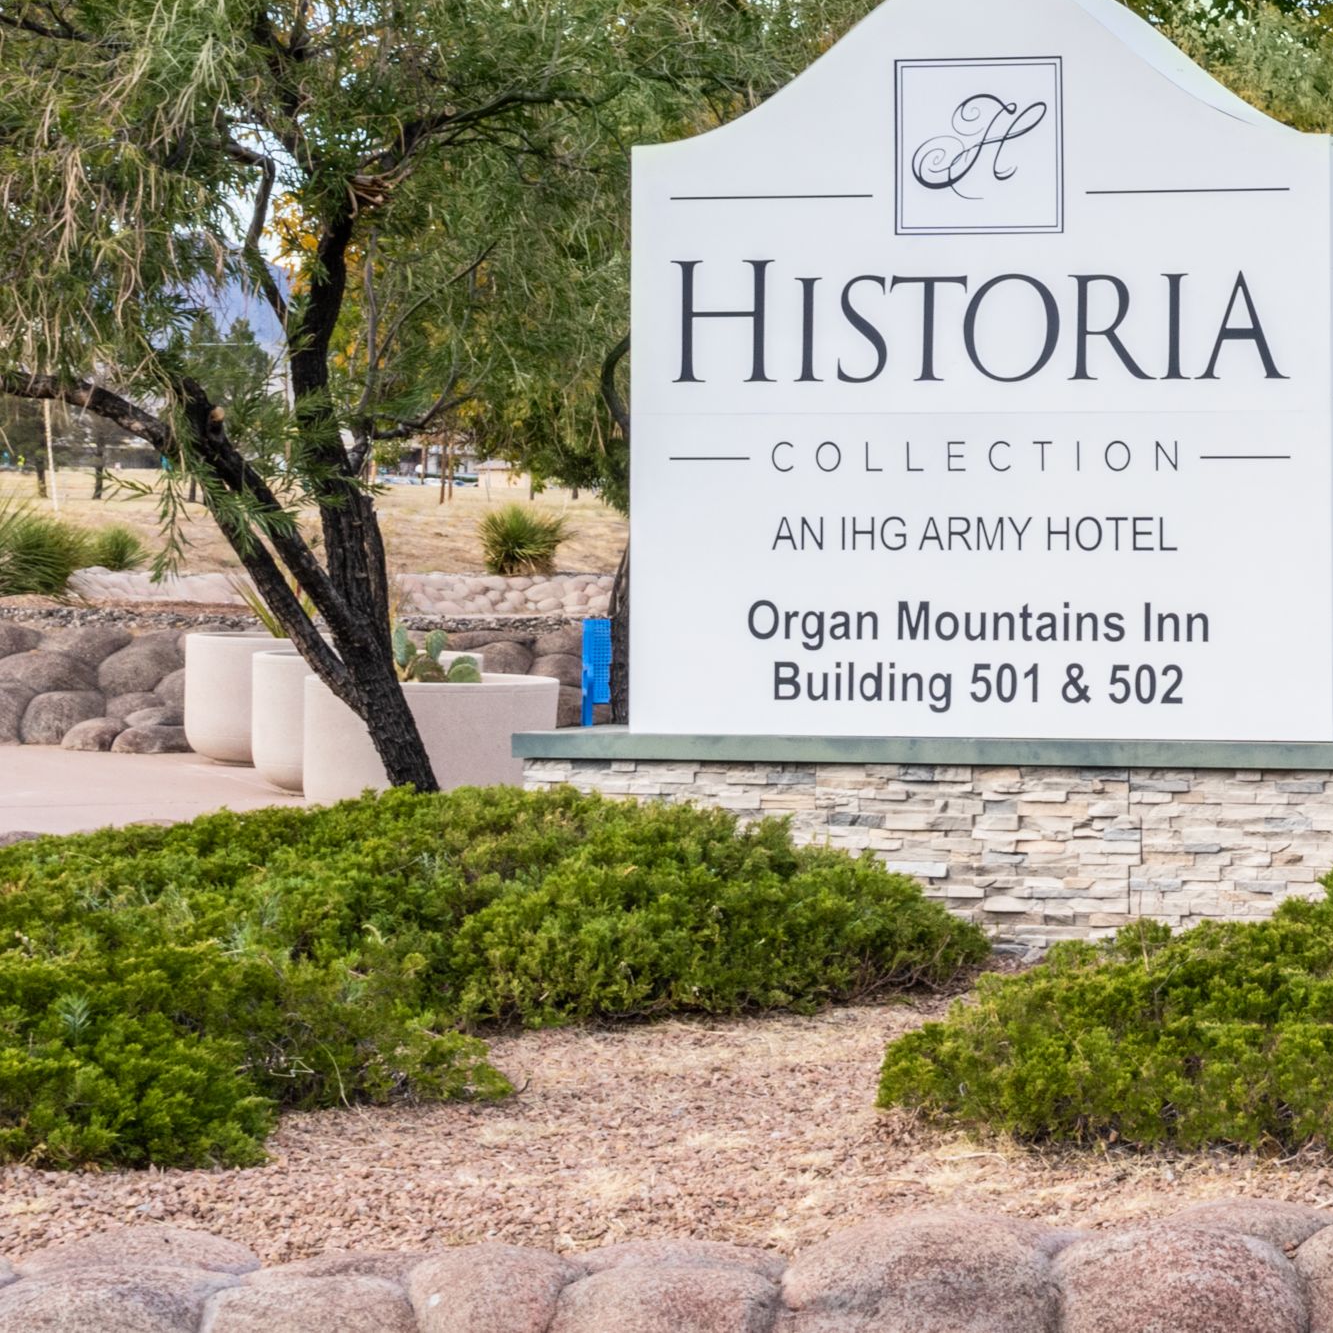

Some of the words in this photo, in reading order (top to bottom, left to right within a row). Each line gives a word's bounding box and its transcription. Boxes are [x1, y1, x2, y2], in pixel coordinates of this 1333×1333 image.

[670, 259, 1291, 384] HISTORIA
[771, 440, 1181, 473] COLLECTION
[772, 516, 824, 551] AN
[841, 516, 907, 552] IHG
[918, 516, 1033, 551] ARMY
[1047, 516, 1178, 552] HOTEL
[747, 599, 879, 651] Organ
[897, 600, 1126, 643] Mountains
[1144, 601, 1209, 643] Inn
[773, 661, 952, 714] Building
[970, 662, 1041, 704] 501
[1060, 662, 1092, 704] &
[1108, 663, 1184, 705] 502
